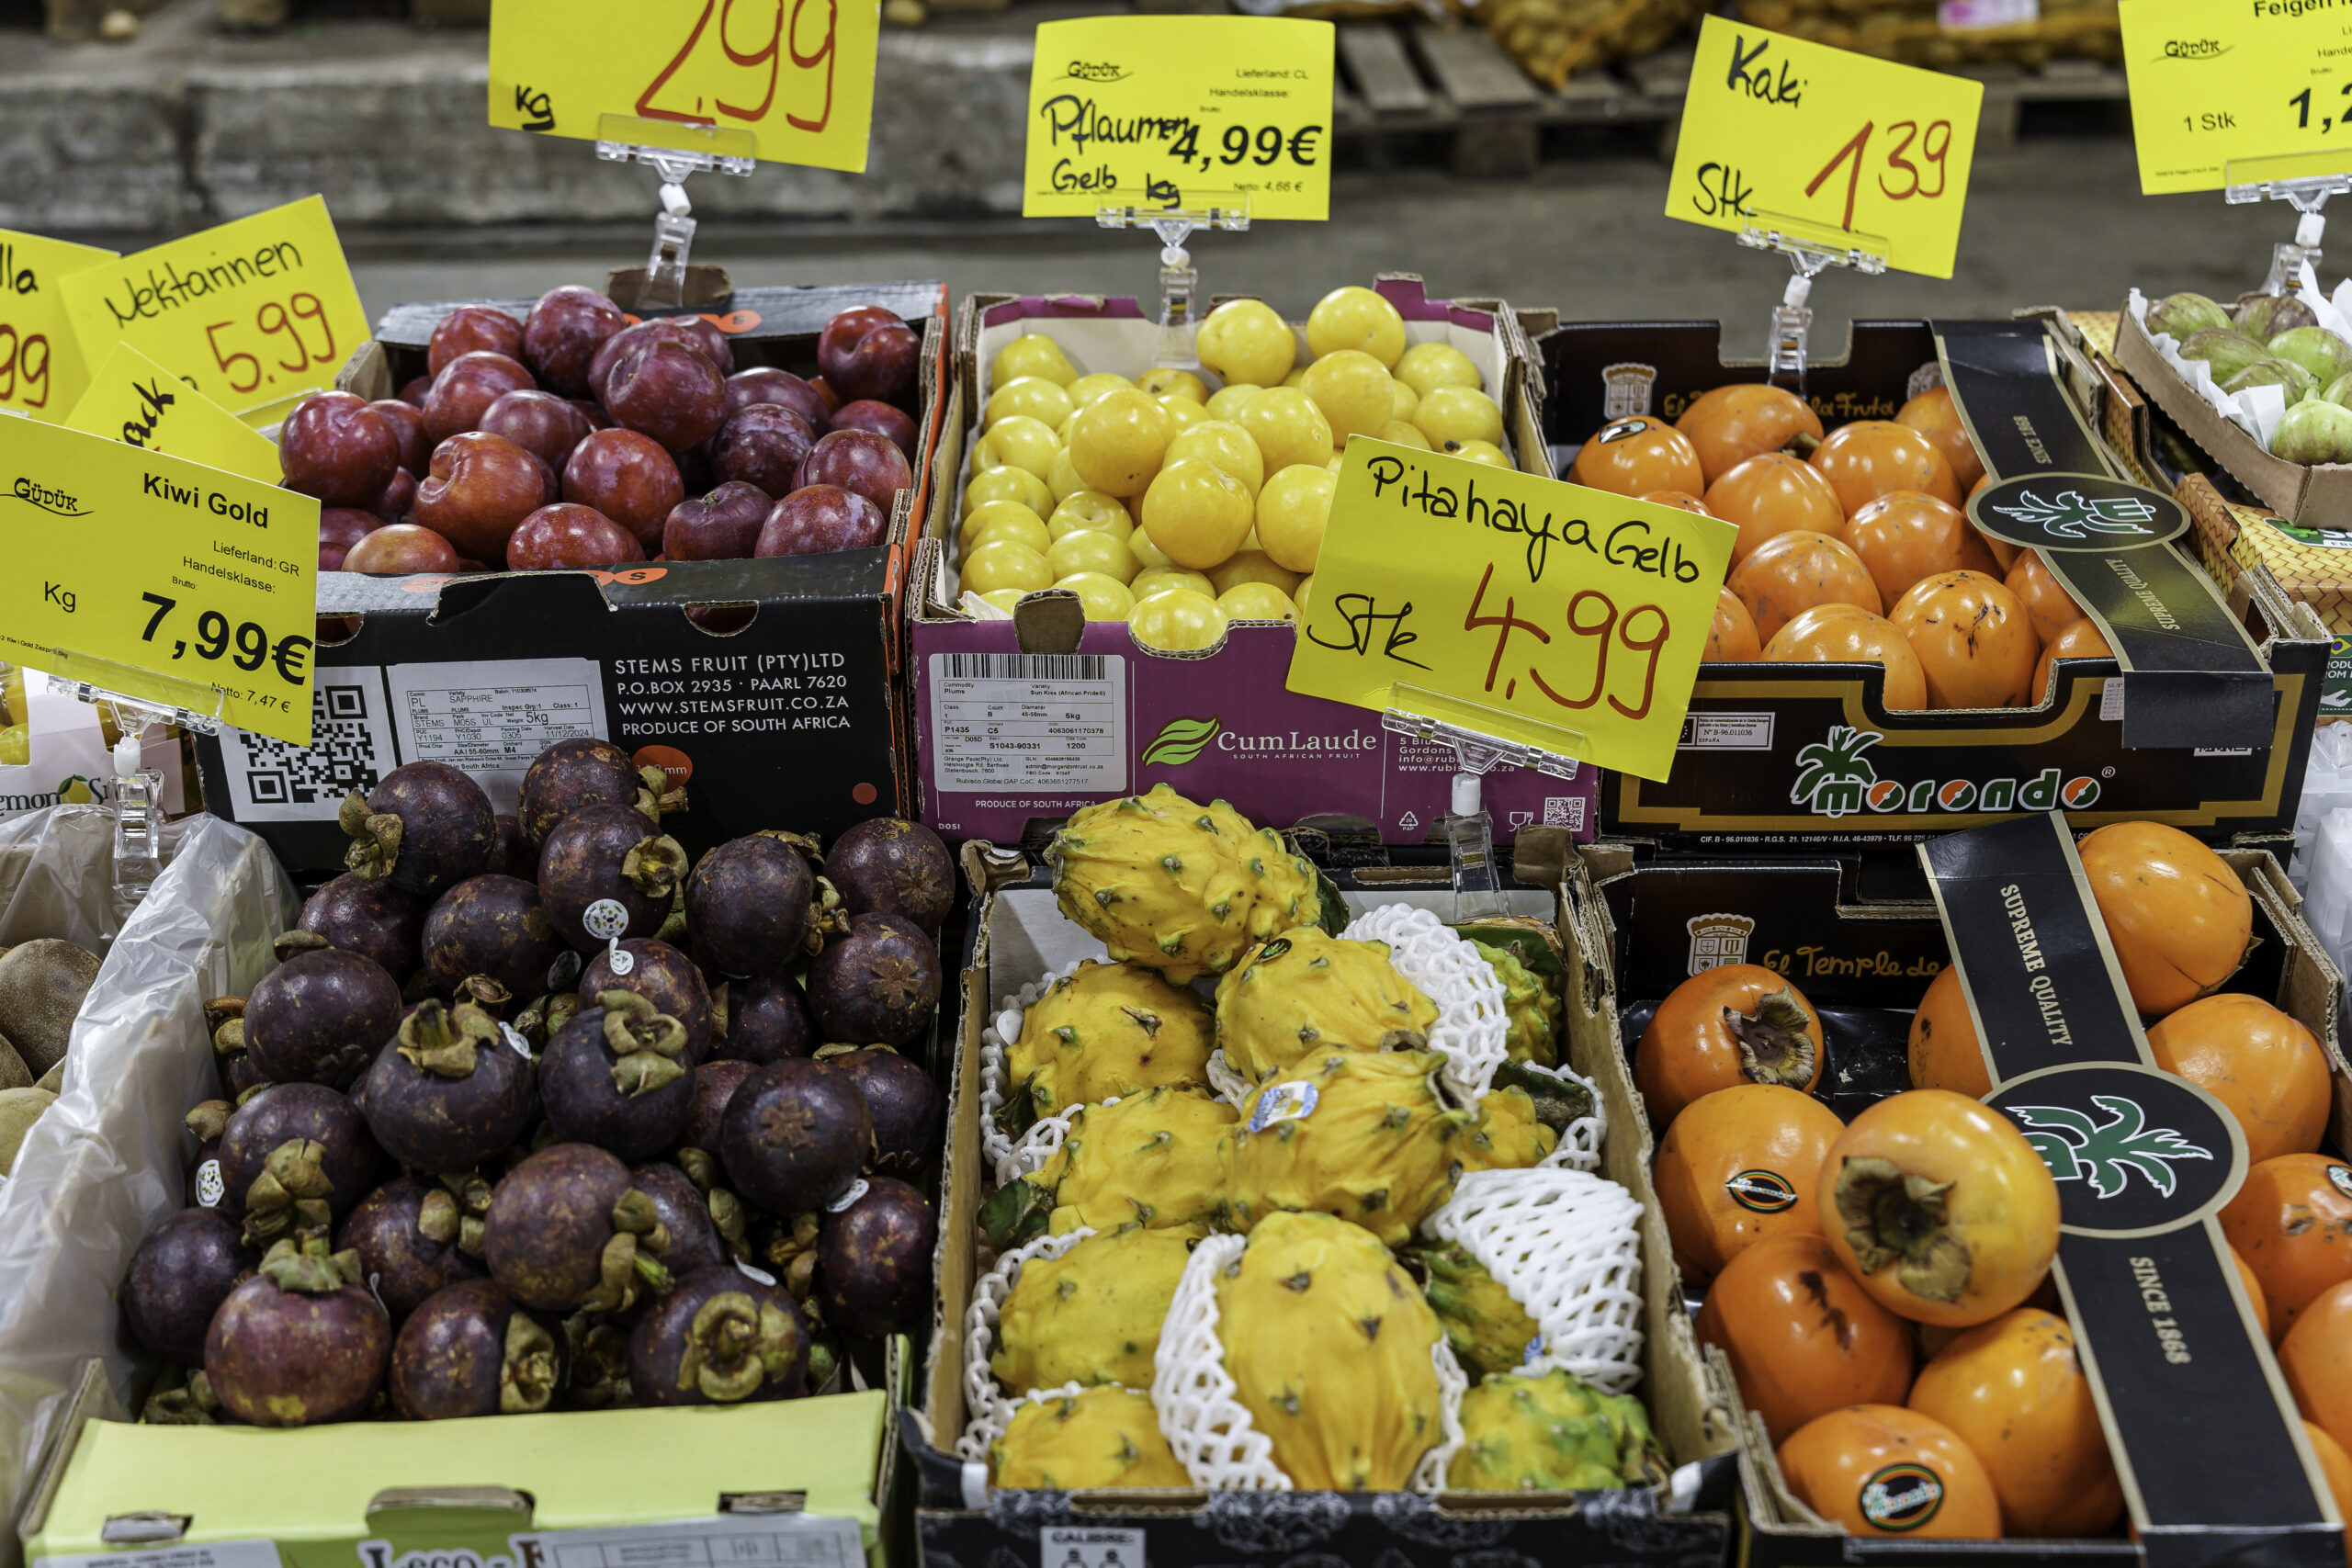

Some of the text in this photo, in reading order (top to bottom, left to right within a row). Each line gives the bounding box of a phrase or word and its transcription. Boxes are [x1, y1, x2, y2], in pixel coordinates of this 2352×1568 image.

[1727, 34, 1809, 108] Kaki
[2184, 112, 2236, 133] 1 Stk
[1168, 124, 1324, 174] 4,99€
[1052, 158, 1118, 192] Gelb
[14, 476, 79, 513] GÜDÜK
[143, 472, 269, 530] Kiwi Gold
[213, 540, 300, 577] Lieferland: GR
[1604, 520, 1700, 583] Gelb
[172, 576, 198, 592] Brutto:
[183, 555, 276, 594] Handelsklasse:
[44, 581, 76, 614] Kg
[2105, 558, 2181, 630] SUPREME QUALITY
[141, 591, 314, 687] 7,99€
[615, 652, 845, 675] STEMS FRUIT (PTY)LTD
[617, 675, 847, 695] P.O.BOX 2935 PAARL 7620
[246, 689, 277, 711] 7,47
[281, 700, 291, 714] €
[412, 697, 426, 707] PL
[449, 694, 493, 704] SAPPHIRE
[619, 695, 849, 716] WWW.STEMSFRUIT.CO.ZA
[414, 719, 445, 728] STEMS
[482, 717, 494, 726] UL
[526, 711, 548, 726] 5kg
[622, 716, 851, 736] PRODUCE OF SOUTH AFRICA
[417, 734, 443, 742] Y1194
[546, 728, 589, 739] 11/12/2024
[504, 746, 516, 754] M4
[975, 800, 1096, 808] PRODUCE OF SOUTH AFRICA
[1763, 945, 1939, 979] El Temple de
[2001, 883, 2074, 1046] SUPREME QUALITY
[2129, 1257, 2192, 1365] SINCE 1868
